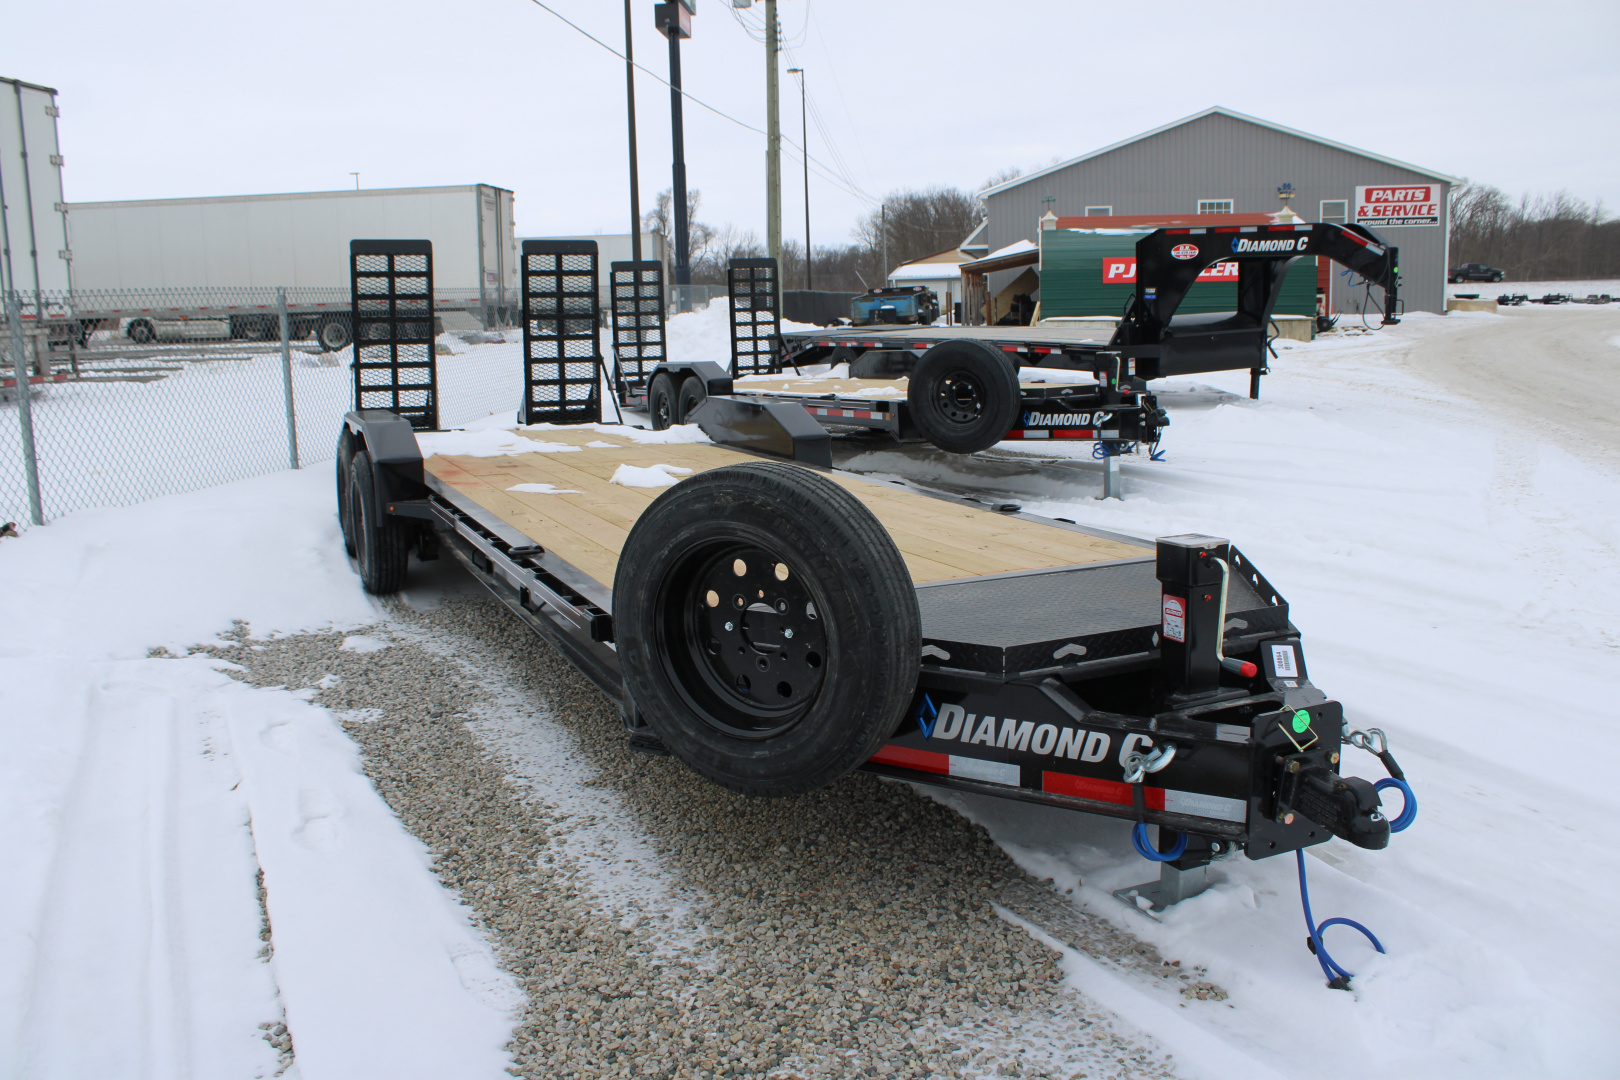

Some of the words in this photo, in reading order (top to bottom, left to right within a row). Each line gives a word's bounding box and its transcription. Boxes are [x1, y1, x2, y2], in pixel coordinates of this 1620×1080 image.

[1371, 189, 1426, 202] PARTS
[1357, 205, 1369, 217] &
[1371, 204, 1437, 217] SERVICE
[1388, 217, 1403, 226] the
[1236, 238, 1295, 253] DIAMOND
[1296, 236, 1309, 251] C
[1108, 263, 1137, 278] PJ
[1028, 411, 1091, 426] DIAMOND
[932, 703, 1111, 763] DIAMOND
